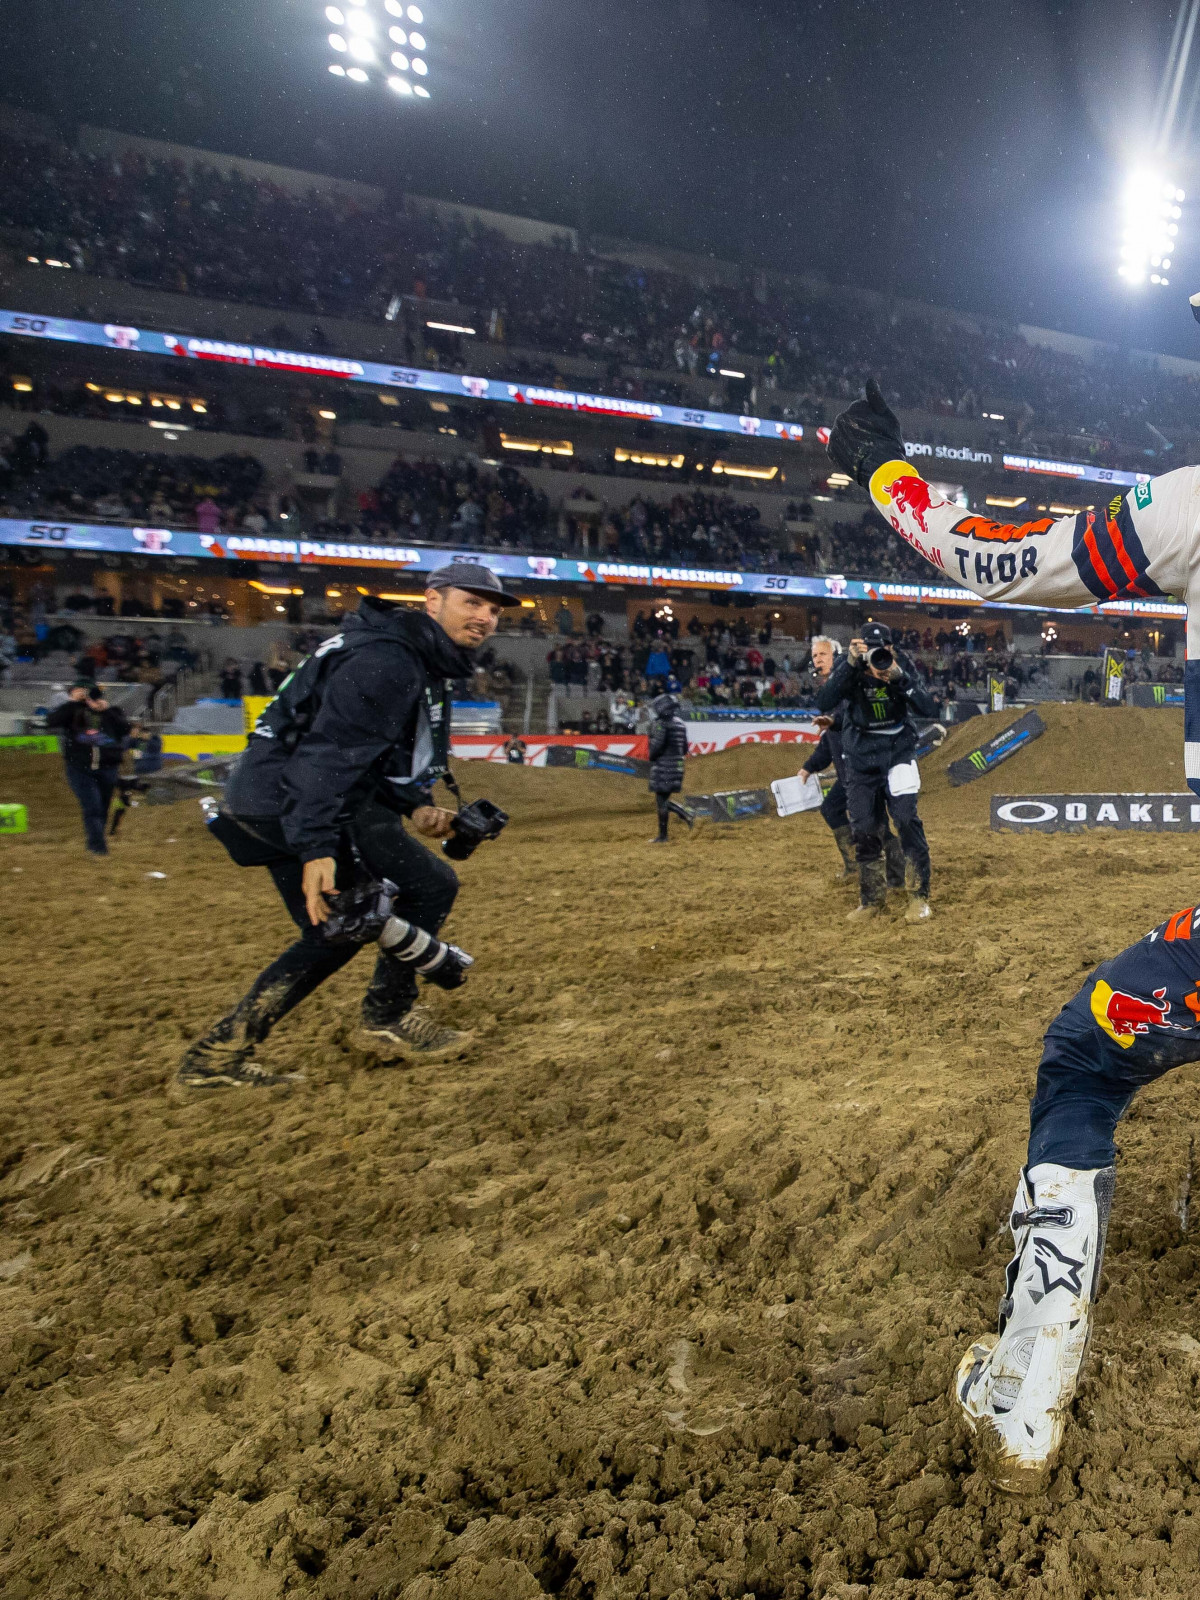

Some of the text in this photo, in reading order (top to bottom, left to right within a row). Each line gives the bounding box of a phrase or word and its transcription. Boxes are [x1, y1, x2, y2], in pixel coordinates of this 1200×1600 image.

[254, 348, 364, 375] PLESSINGER
[577, 394, 662, 417] PLESSINGER
[904, 441, 993, 464] gon stadium
[1029, 458, 1085, 476] PLESSINGER
[226, 536, 297, 554] AARON
[300, 541, 421, 563] PLESSINGER
[597, 563, 649, 578] AARON
[652, 567, 743, 584] PLESSINGER
[954, 545, 1038, 584] THOR
[878, 584, 919, 596] AARON
